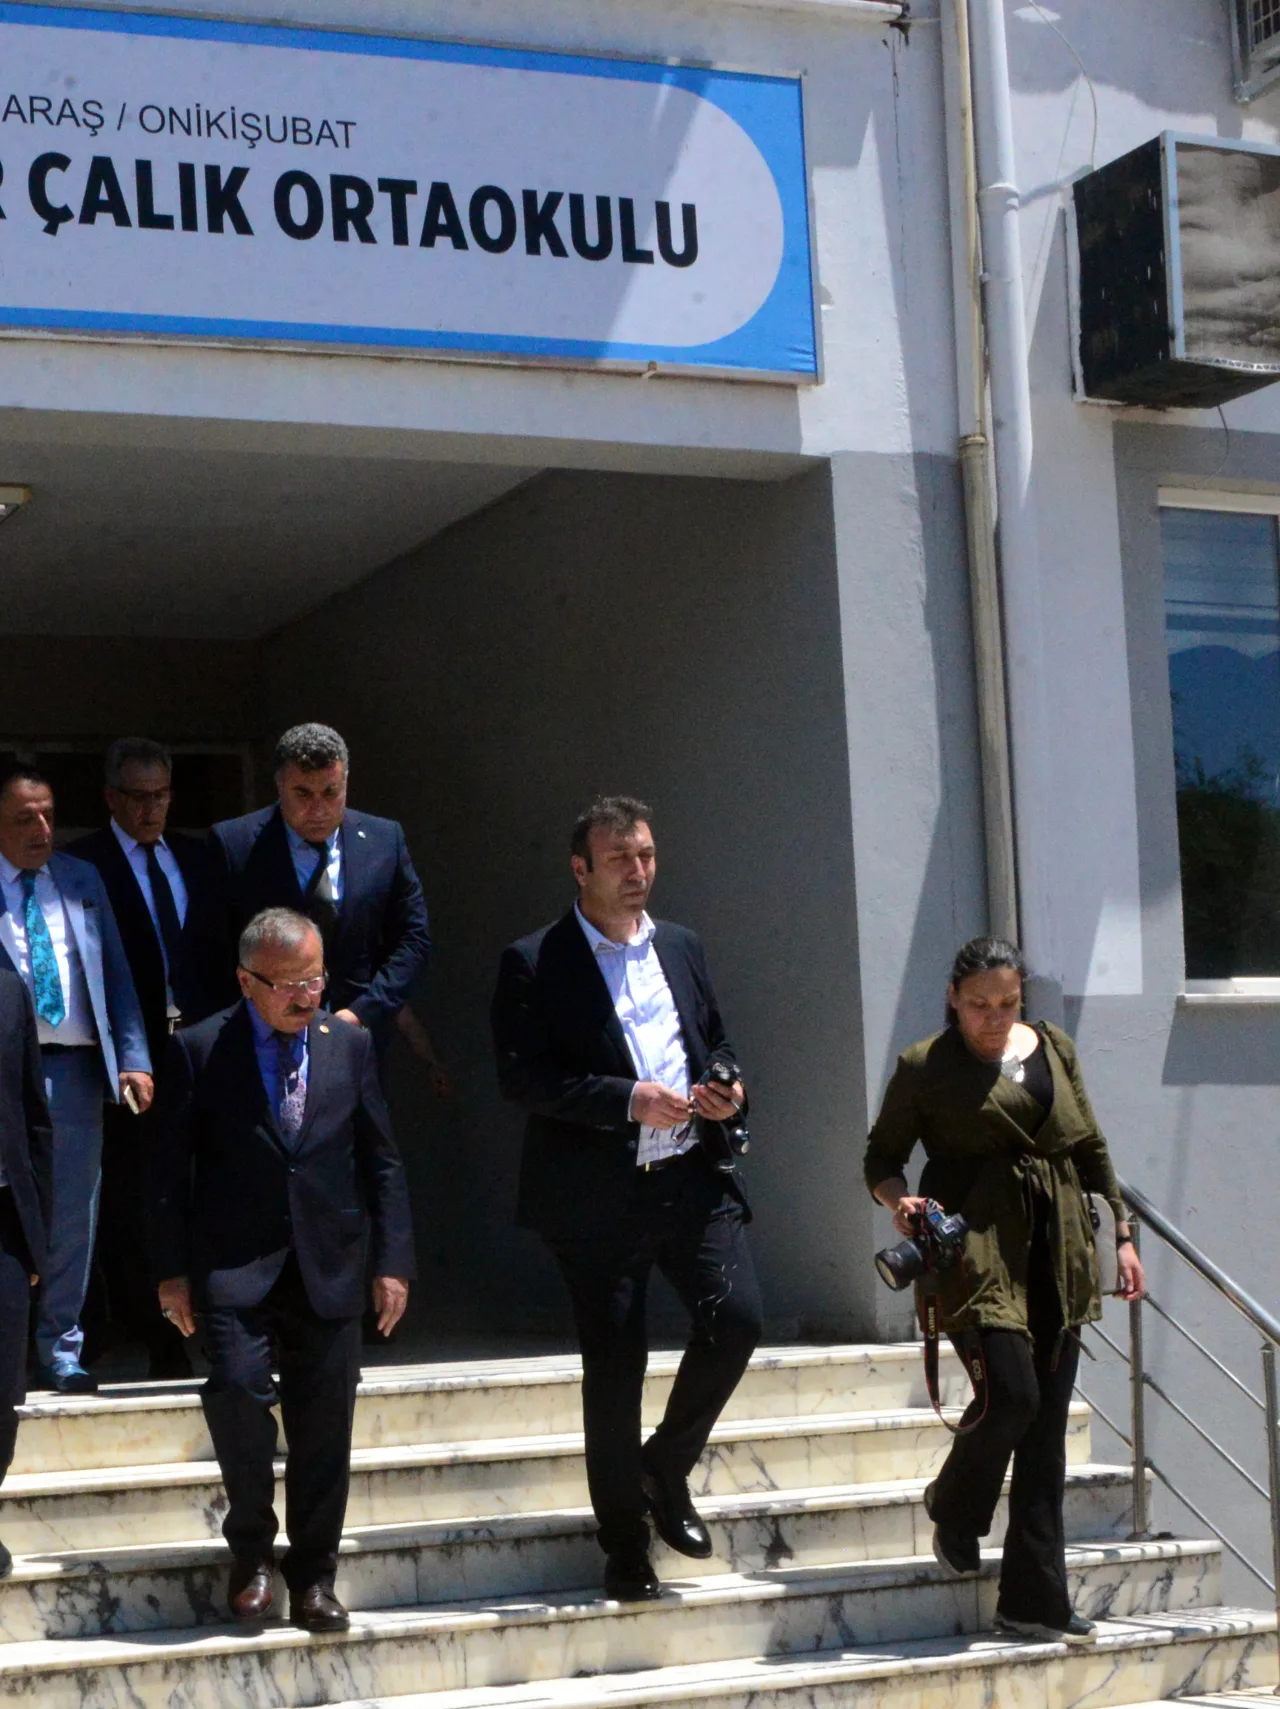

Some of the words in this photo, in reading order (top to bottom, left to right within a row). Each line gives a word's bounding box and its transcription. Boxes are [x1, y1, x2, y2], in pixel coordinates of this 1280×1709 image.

[139, 102, 357, 149] ONİKİŞUBAT
[27, 151, 254, 237] ÇALIK
[274, 169, 699, 268] ORTAOKULU
